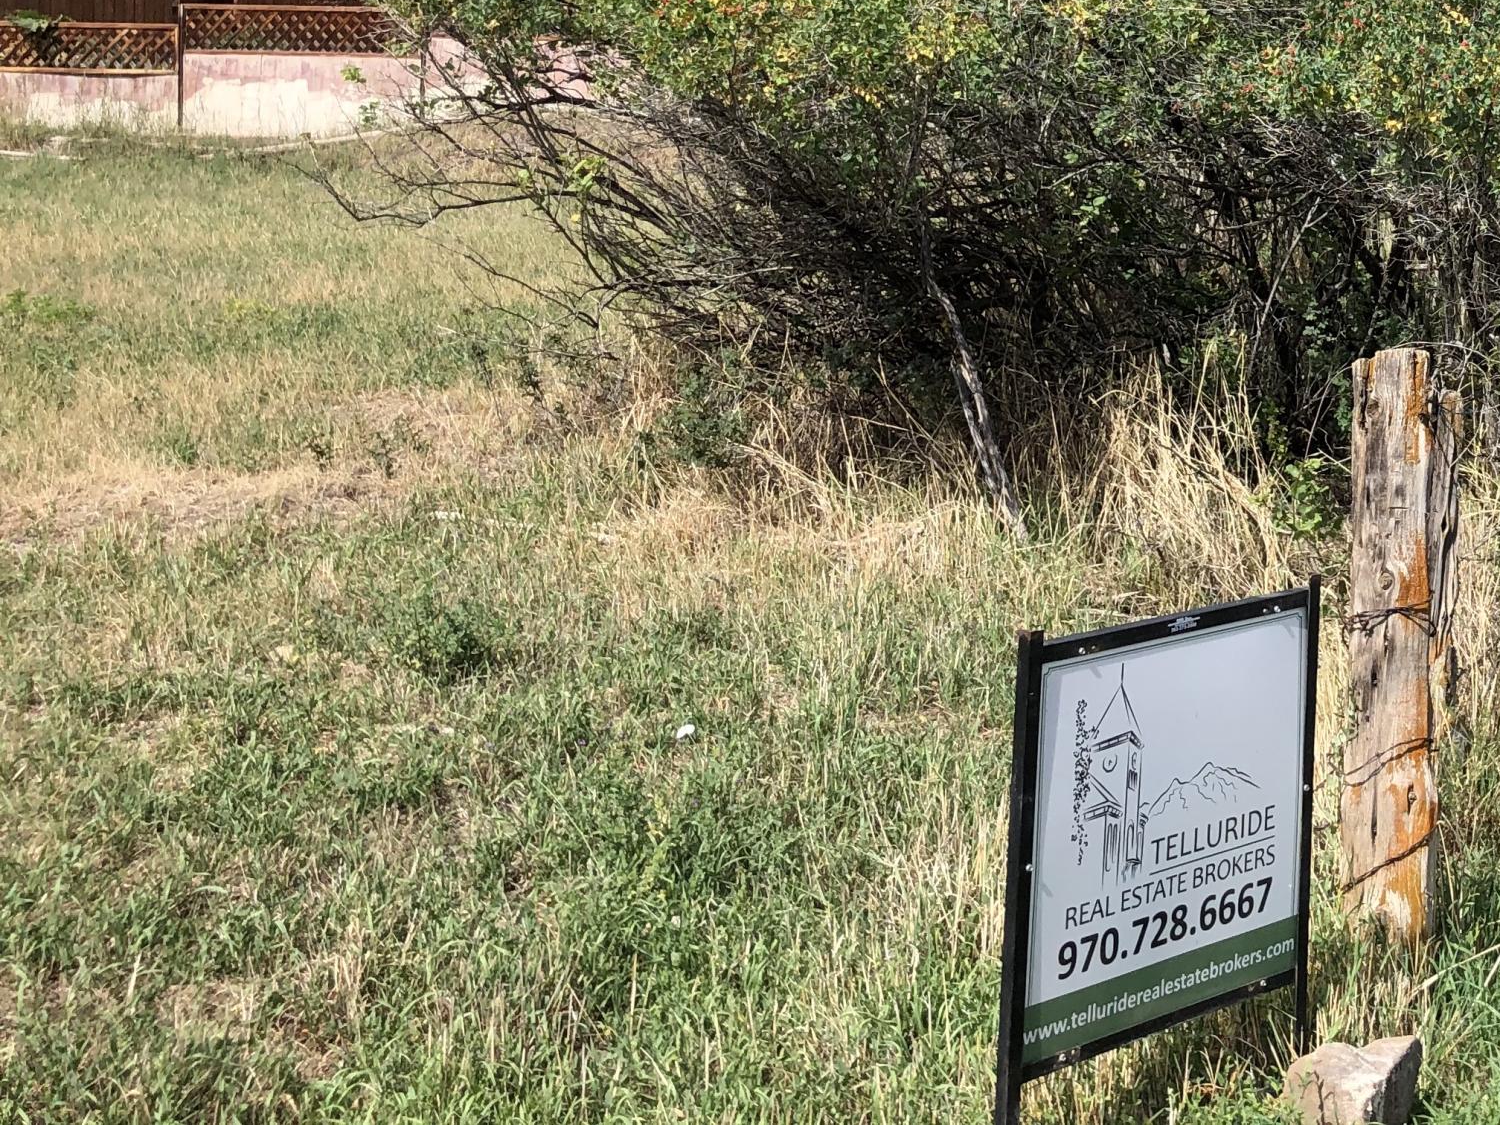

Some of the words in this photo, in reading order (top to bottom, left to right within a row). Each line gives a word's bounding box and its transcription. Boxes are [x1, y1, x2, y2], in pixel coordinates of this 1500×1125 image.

[1151, 805, 1276, 864] TELLURIDE
[1057, 876, 1273, 980] 970.728.6667
[1065, 896, 1115, 930] REAL
[1121, 871, 1187, 912] ESTATE
[1192, 844, 1275, 889] BROKERS
[1023, 936, 1294, 1045] www.telluriderealestatebrokers.com
